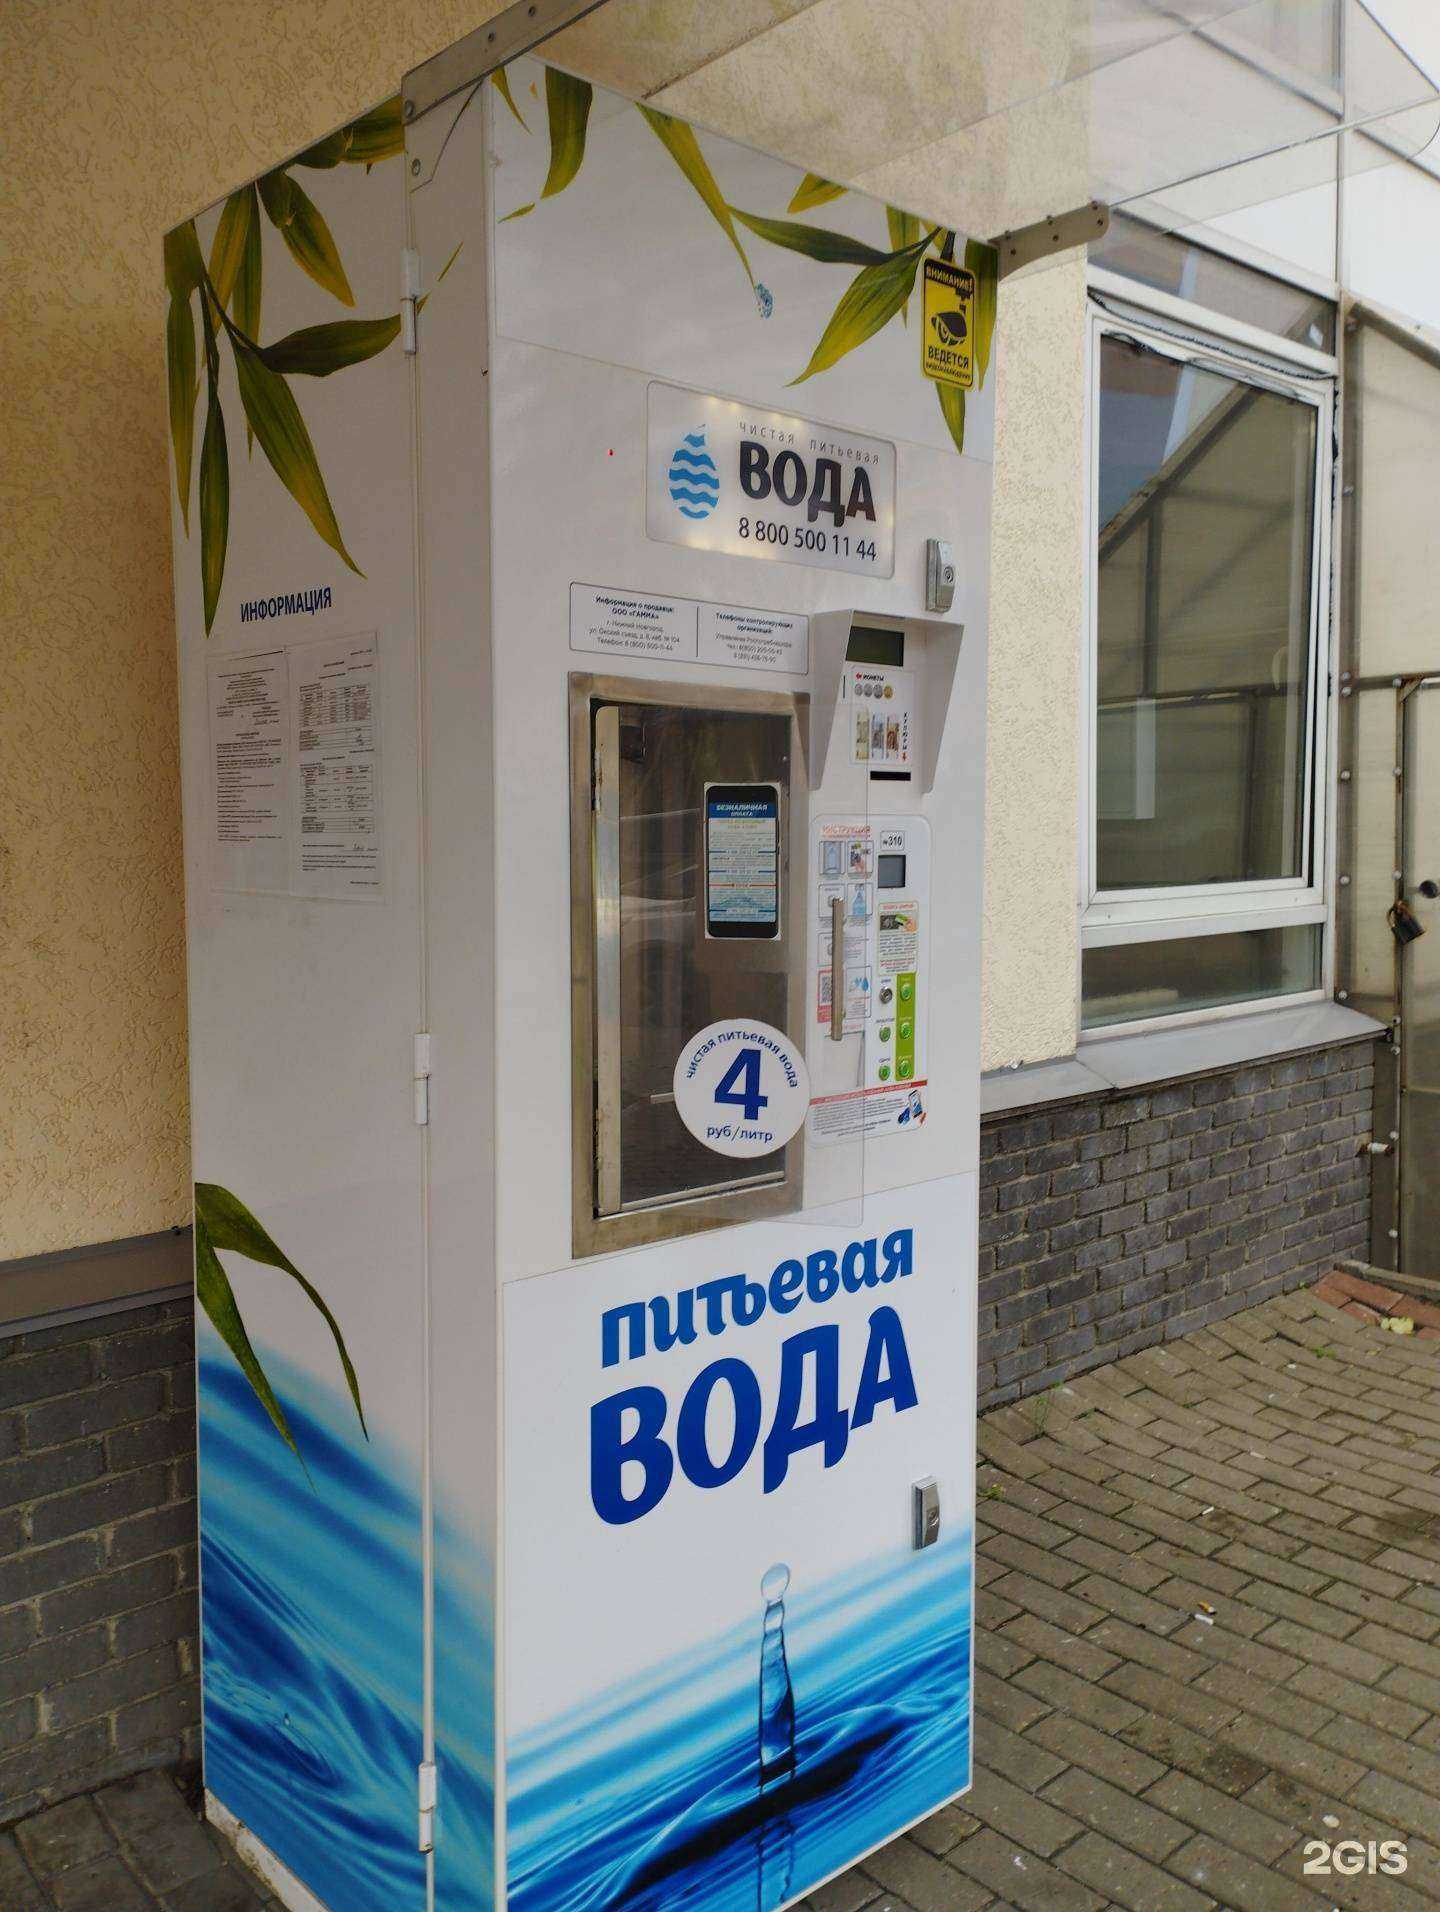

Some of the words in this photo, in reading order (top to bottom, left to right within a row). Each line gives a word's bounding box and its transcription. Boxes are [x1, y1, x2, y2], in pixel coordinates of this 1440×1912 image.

[928, 345, 969, 369] ВЕДЕТСЯ
[740, 422, 795, 443] чистая
[809, 439, 879, 464] питьевая
[740, 441, 876, 527] ВОДА
[739, 517, 750, 538] 8
[755, 520, 789, 545] 800
[794, 528, 826, 552] 500
[832, 534, 849, 556] 11
[856, 540, 877, 561] 44
[240, 587, 332, 622] ИНФОРМАЦИЯ
[687, 1037, 716, 1079] чистая
[718, 1030, 781, 1054] питьевая
[778, 1052, 799, 1088] вода
[714, 1048, 769, 1121] 4
[706, 1125, 773, 1144] руб/литр
[602, 1228, 913, 1369] питьевая
[590, 1305, 919, 1525] ВОДА
